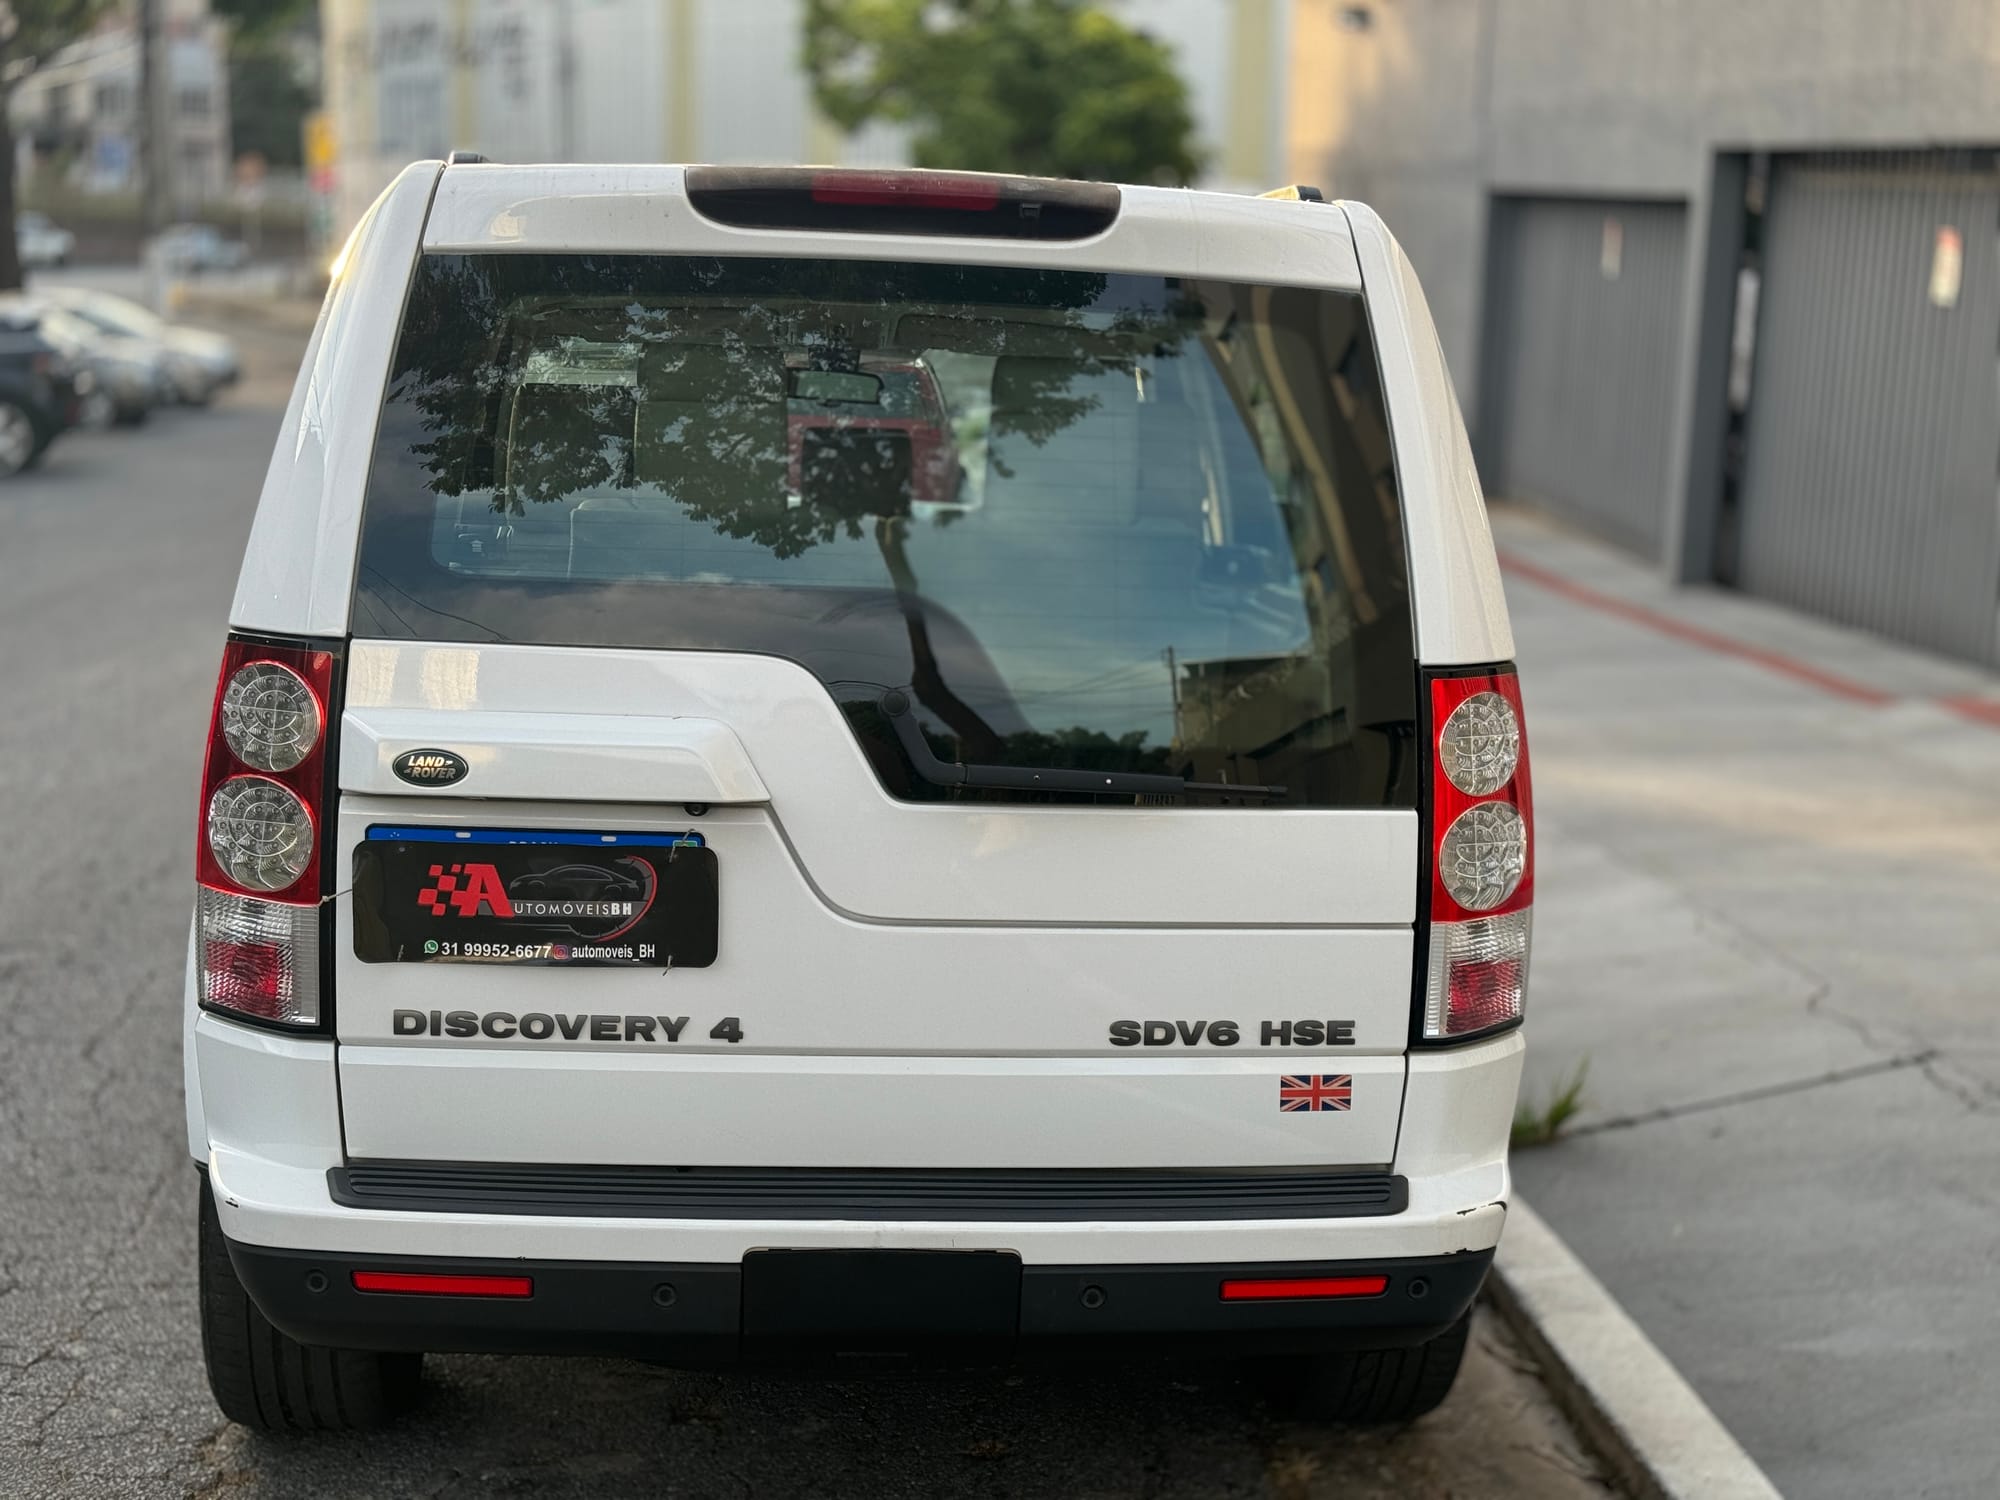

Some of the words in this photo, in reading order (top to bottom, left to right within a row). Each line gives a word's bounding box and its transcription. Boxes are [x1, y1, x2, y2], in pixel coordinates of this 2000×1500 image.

[407, 755, 445, 768] LAND
[411, 766, 457, 779] ROVER
[441, 943, 458, 956] 31
[464, 943, 552, 959] 99952-6677
[572, 944, 656, 962] automoveis_BH
[393, 1009, 690, 1042] DISCOVERY
[710, 1016, 744, 1043] 4
[1109, 1020, 1241, 1046] SDV6
[1260, 1020, 1356, 1046] HSE
